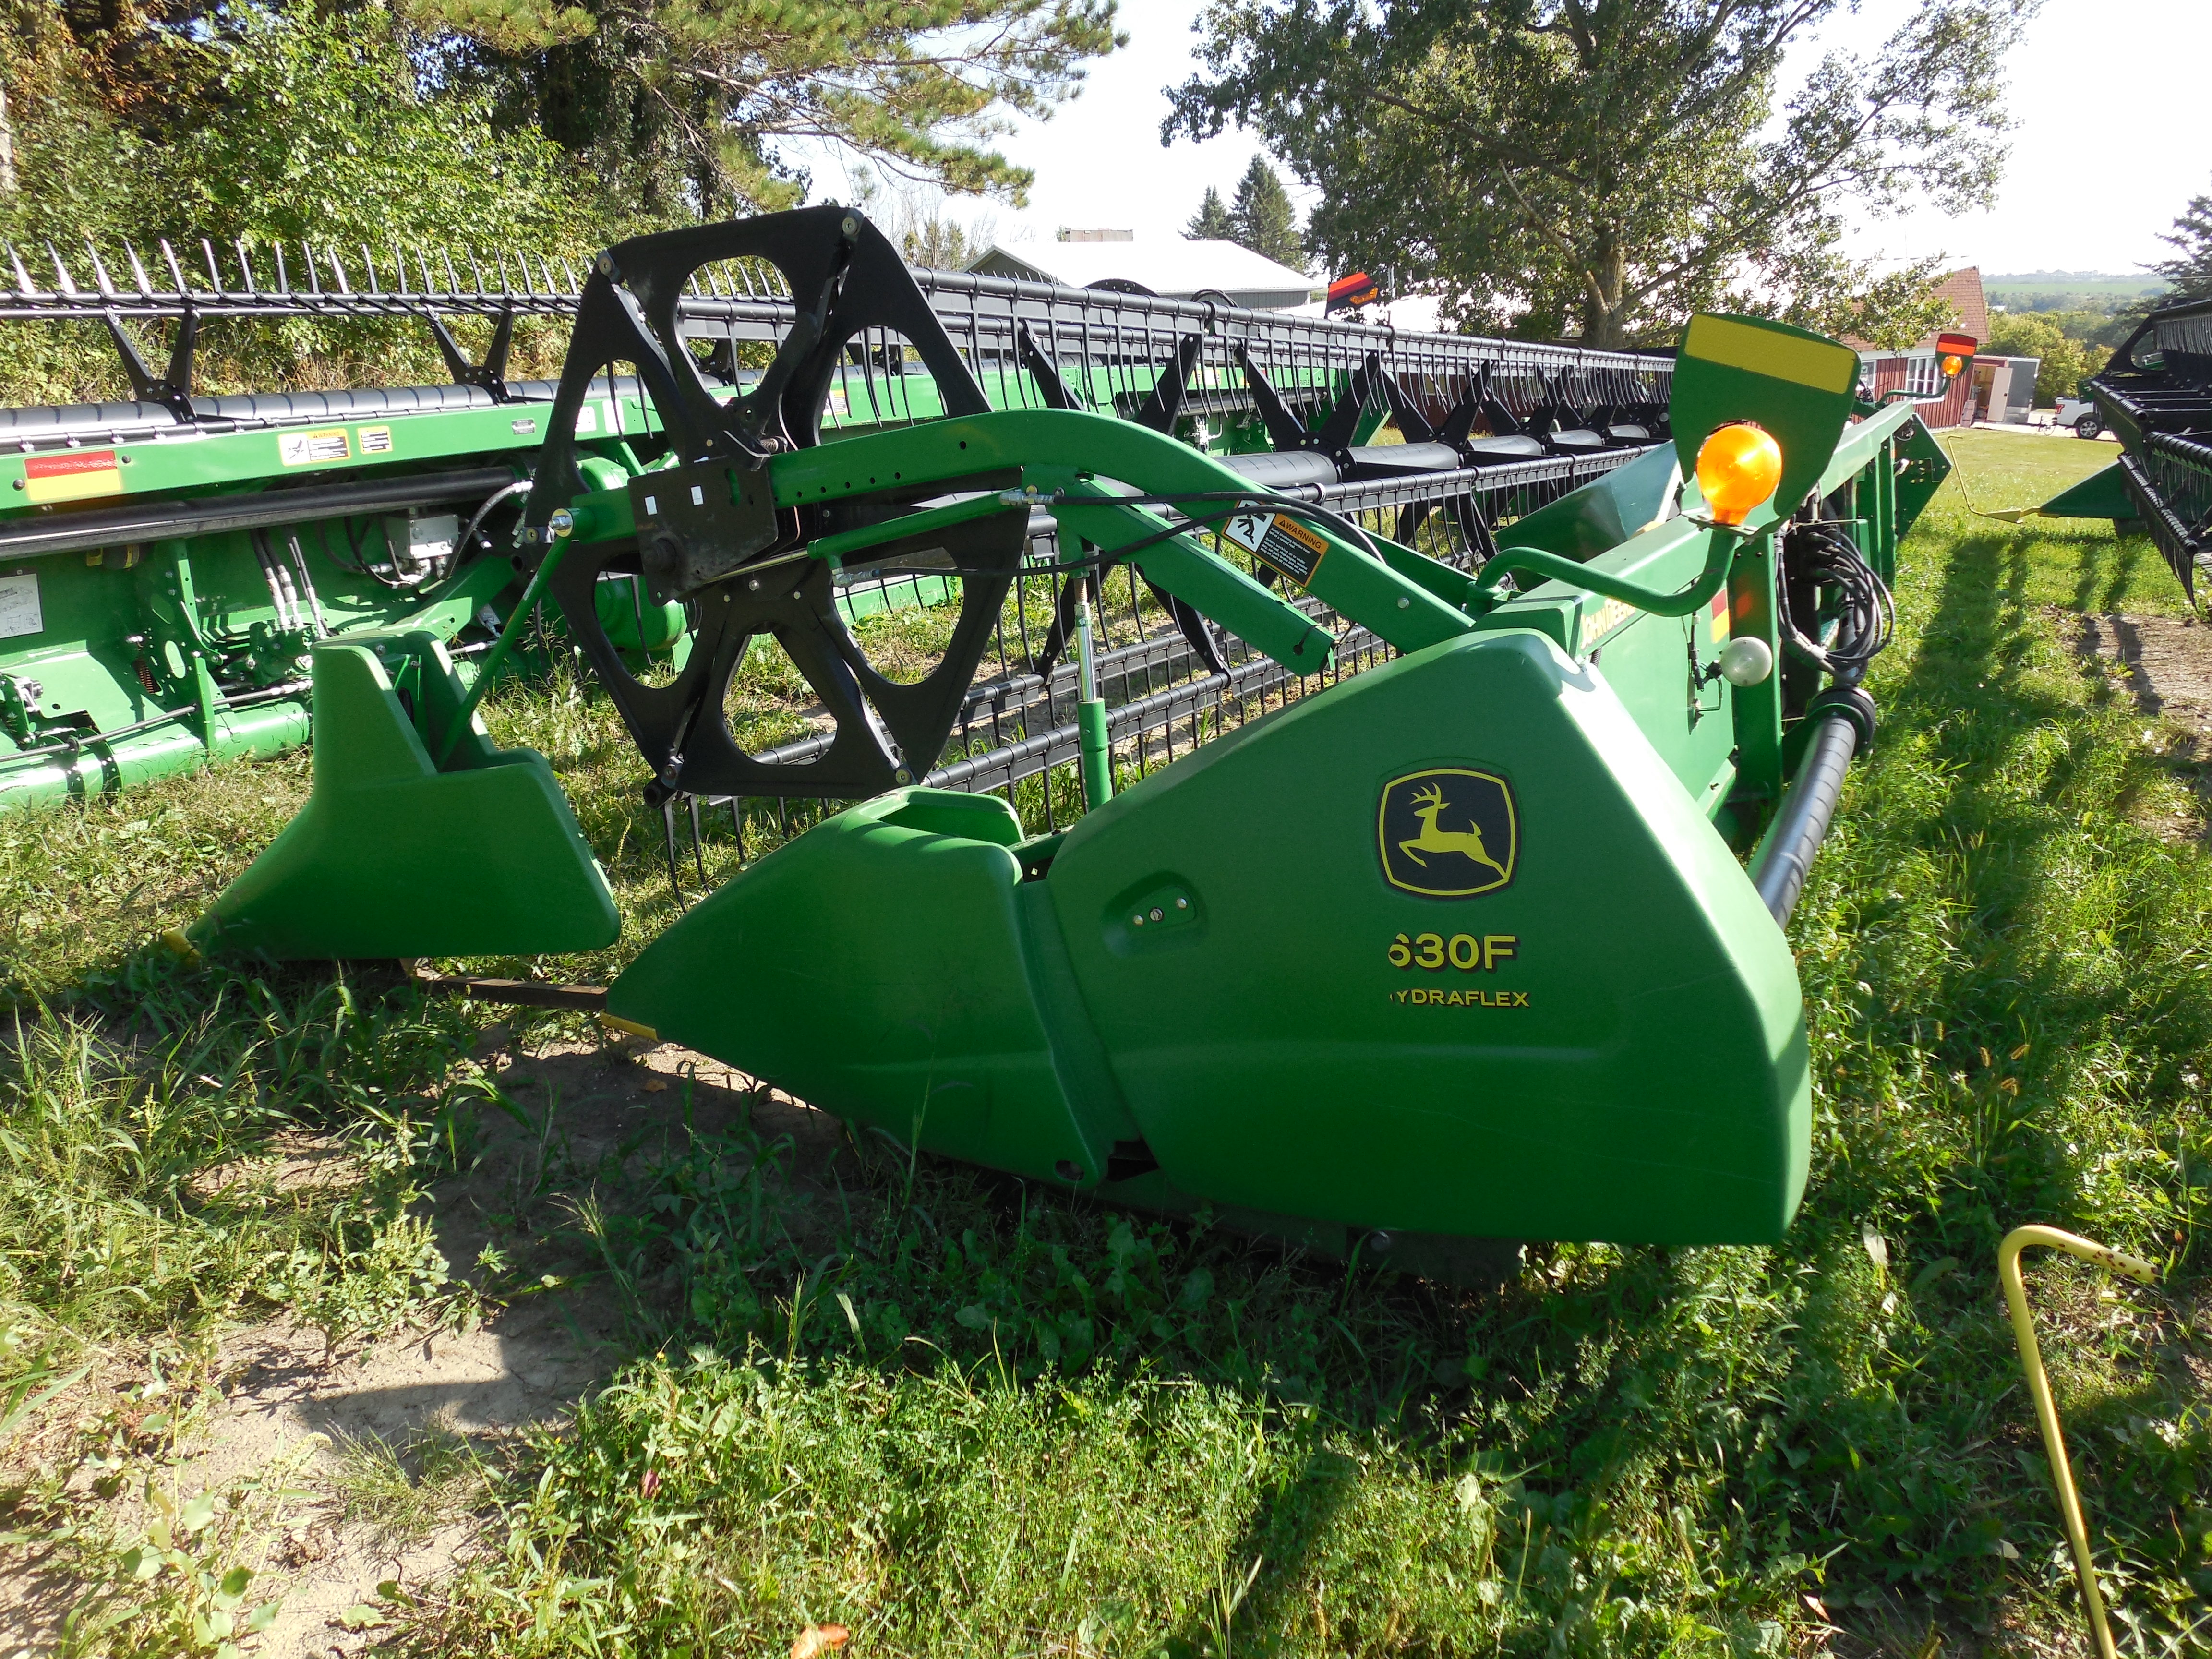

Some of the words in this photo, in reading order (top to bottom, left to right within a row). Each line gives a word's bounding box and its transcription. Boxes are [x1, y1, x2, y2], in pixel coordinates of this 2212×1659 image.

[1285, 522, 1322, 549] WARNING
[1580, 608, 1607, 649] JOHN
[1388, 933, 1517, 970] 630F
[1390, 988, 1530, 1007] YDRAFLEX
